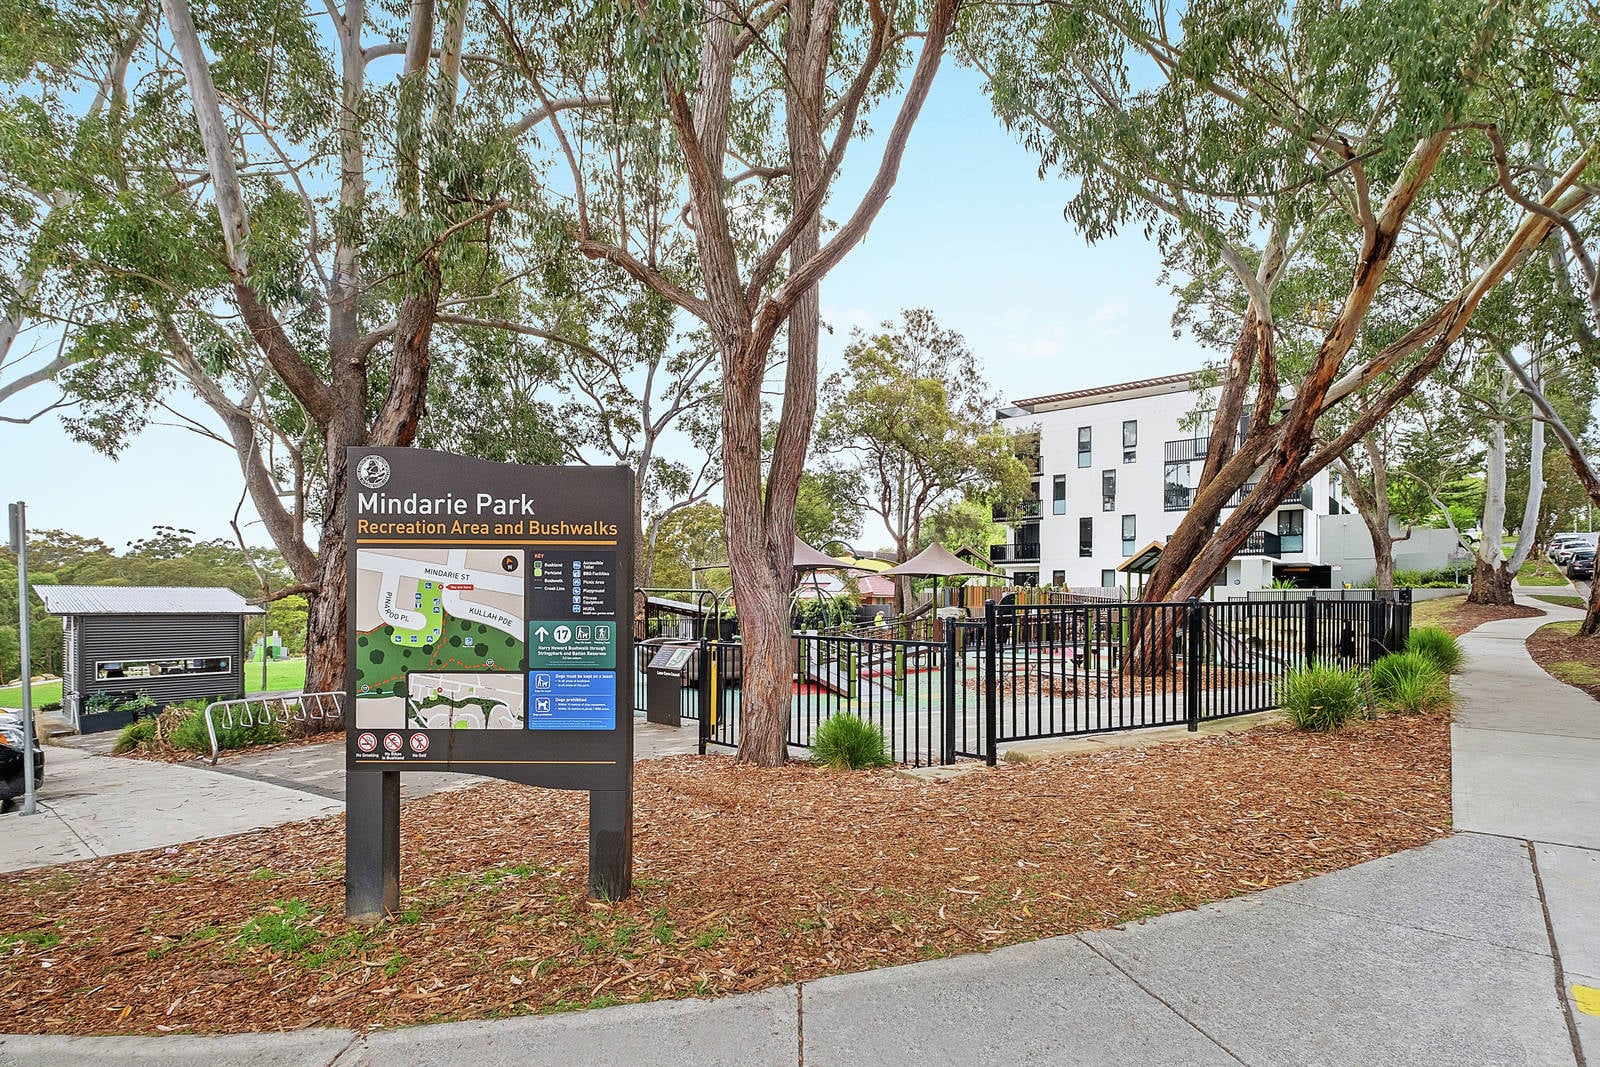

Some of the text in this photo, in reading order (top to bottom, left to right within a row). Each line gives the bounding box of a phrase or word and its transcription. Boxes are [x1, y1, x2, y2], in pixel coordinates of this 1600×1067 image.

[358, 492, 535, 516] Mindarie Park
[358, 520, 618, 535] Recreation Area and Bushwalks
[424, 568, 458, 579] MINDARIE
[469, 607, 513, 626] KULLAH PDE
[556, 630, 568, 640] 17
